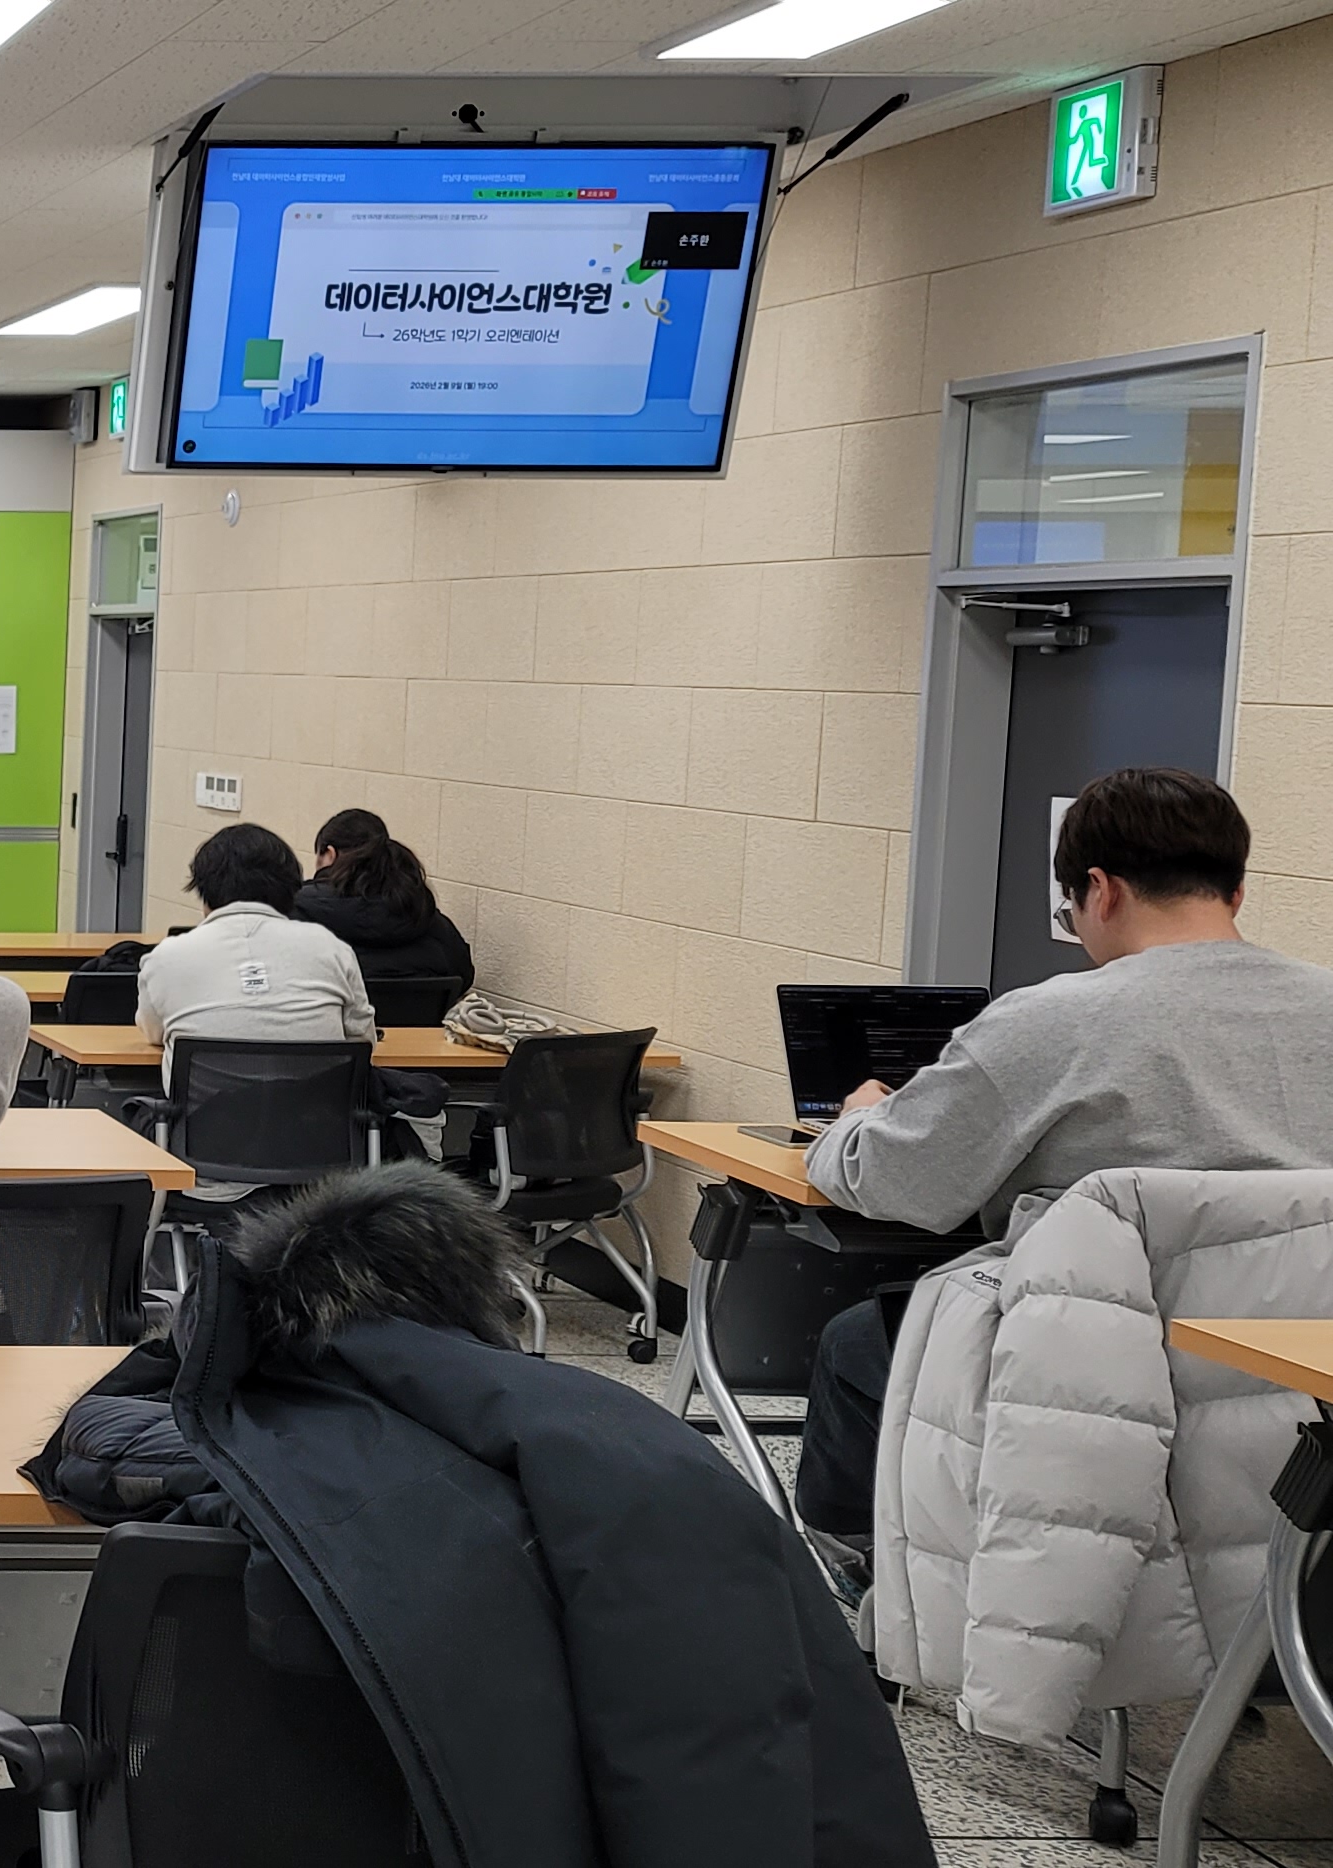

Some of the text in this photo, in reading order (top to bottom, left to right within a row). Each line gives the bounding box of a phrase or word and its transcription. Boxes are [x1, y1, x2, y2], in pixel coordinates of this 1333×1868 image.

[324, 281, 612, 315] 데이터사이언스대학원
[393, 327, 560, 344] 26학년도 1학기 오리엔테이션
